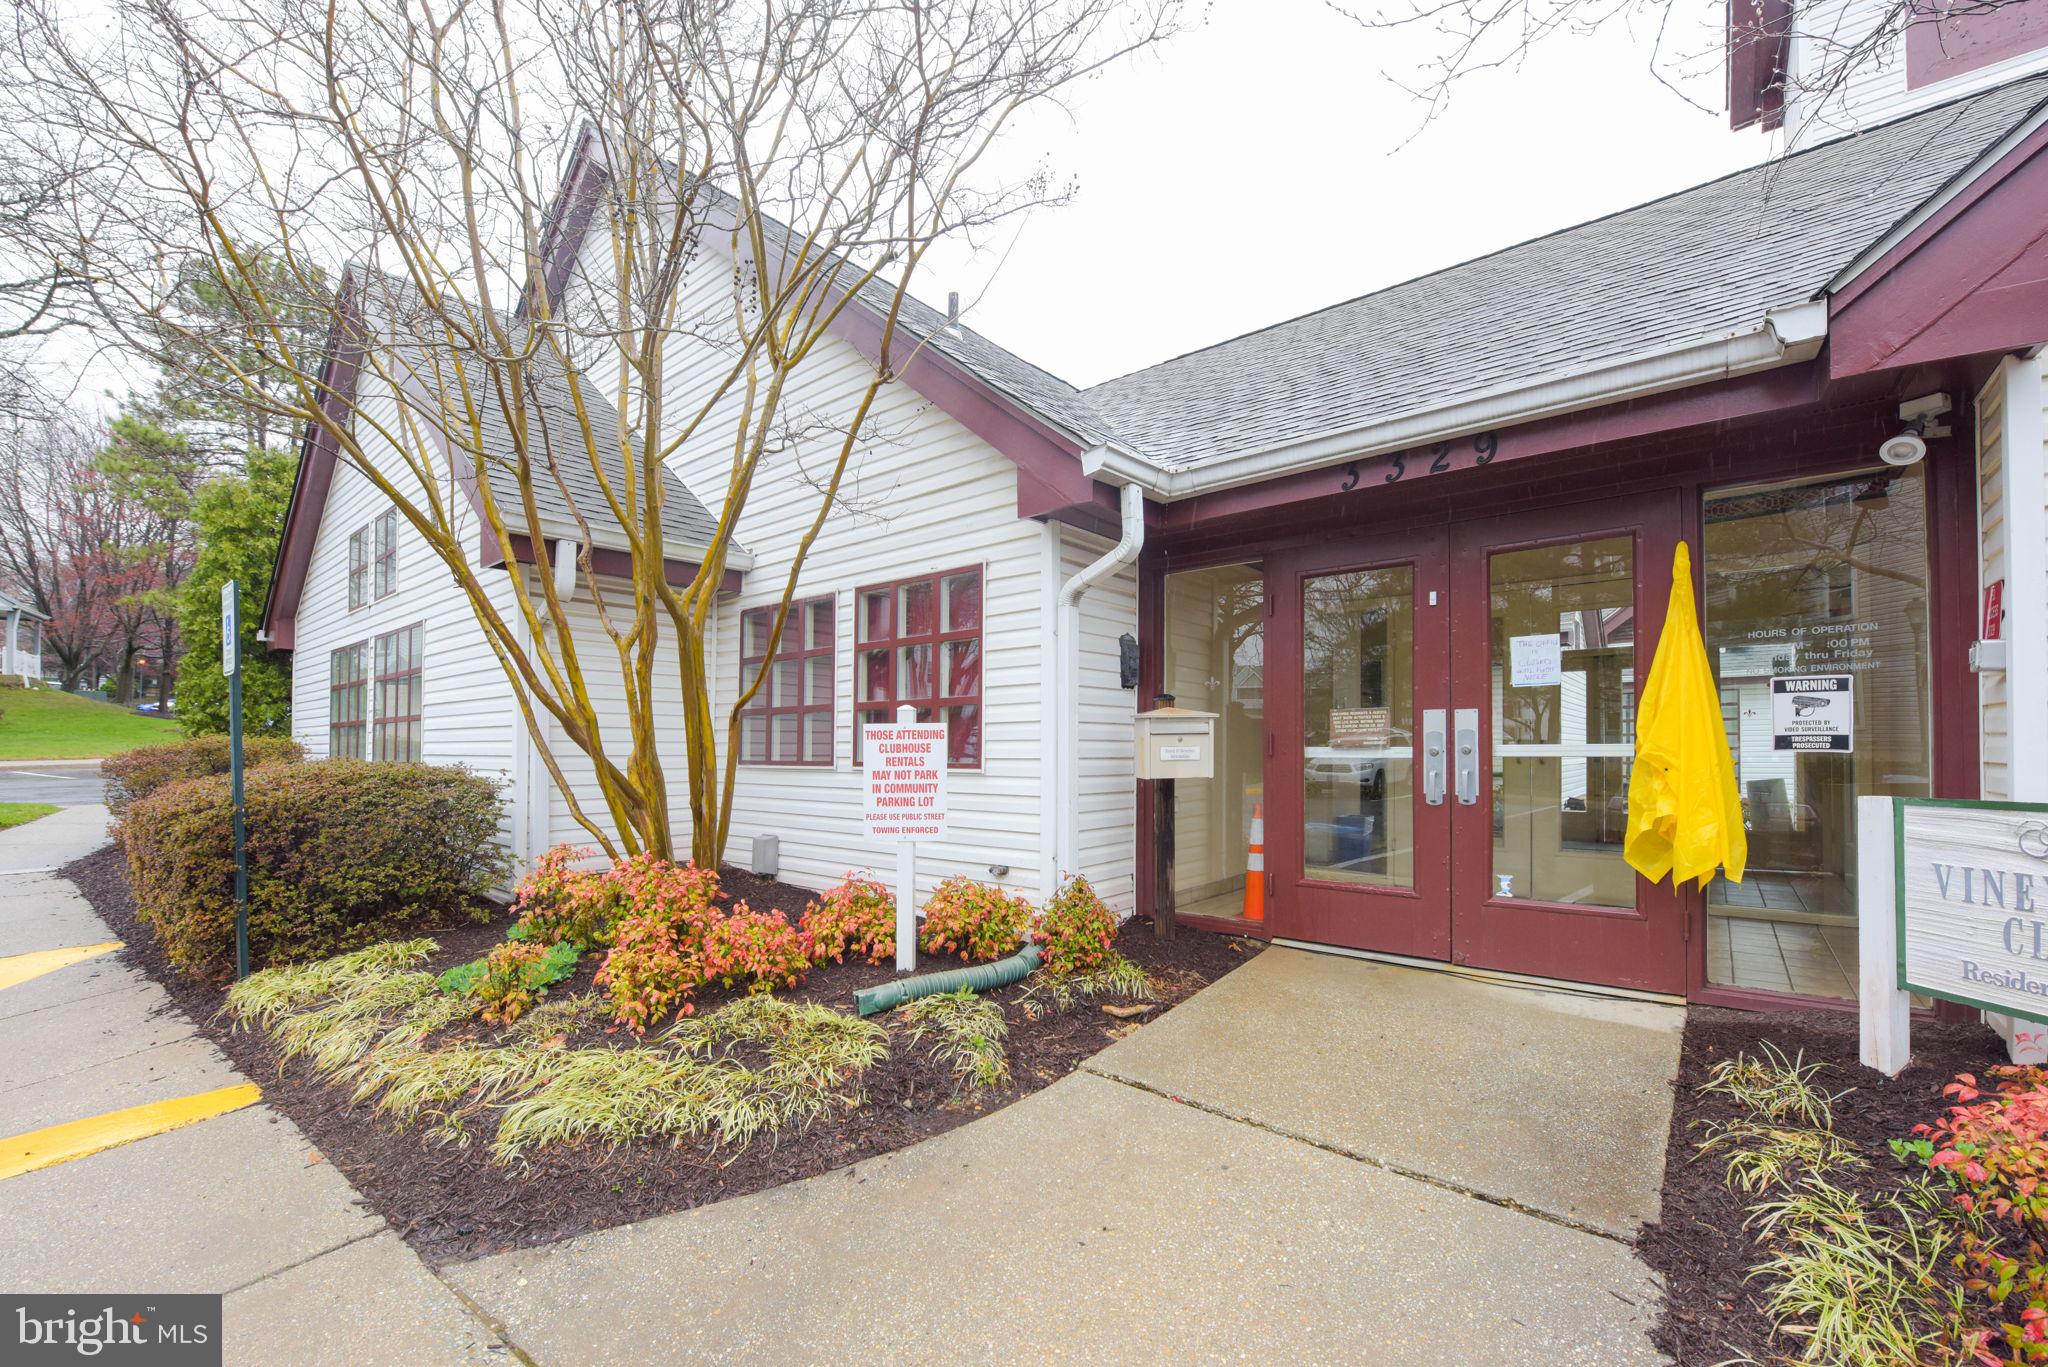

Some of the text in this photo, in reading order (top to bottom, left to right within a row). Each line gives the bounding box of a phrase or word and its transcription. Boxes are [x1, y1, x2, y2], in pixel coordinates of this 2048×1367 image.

[1747, 622, 1879, 639] HOURS OF OPERATION
[1851, 637, 1870, 646] PM
[1805, 651, 1829, 660] thru
[1834, 648, 1873, 659] Friday
[1811, 661, 1881, 672] ENVIRONMENT
[1785, 679, 1838, 692] WARNING
[865, 729, 945, 740] THOSE ATTENDING
[879, 743, 931, 753] CLUBHOUSE
[885, 756, 925, 767] RENTALS
[872, 770, 938, 780] MAY NOT PARK
[872, 783, 939, 794] IN COMMUNITY
[876, 796, 935, 807] PARKING LOT
[866, 813, 888, 821] PLEASE
[872, 826, 939, 834] TOWING ENFORCED
[1932, 863, 2048, 914] VINE
